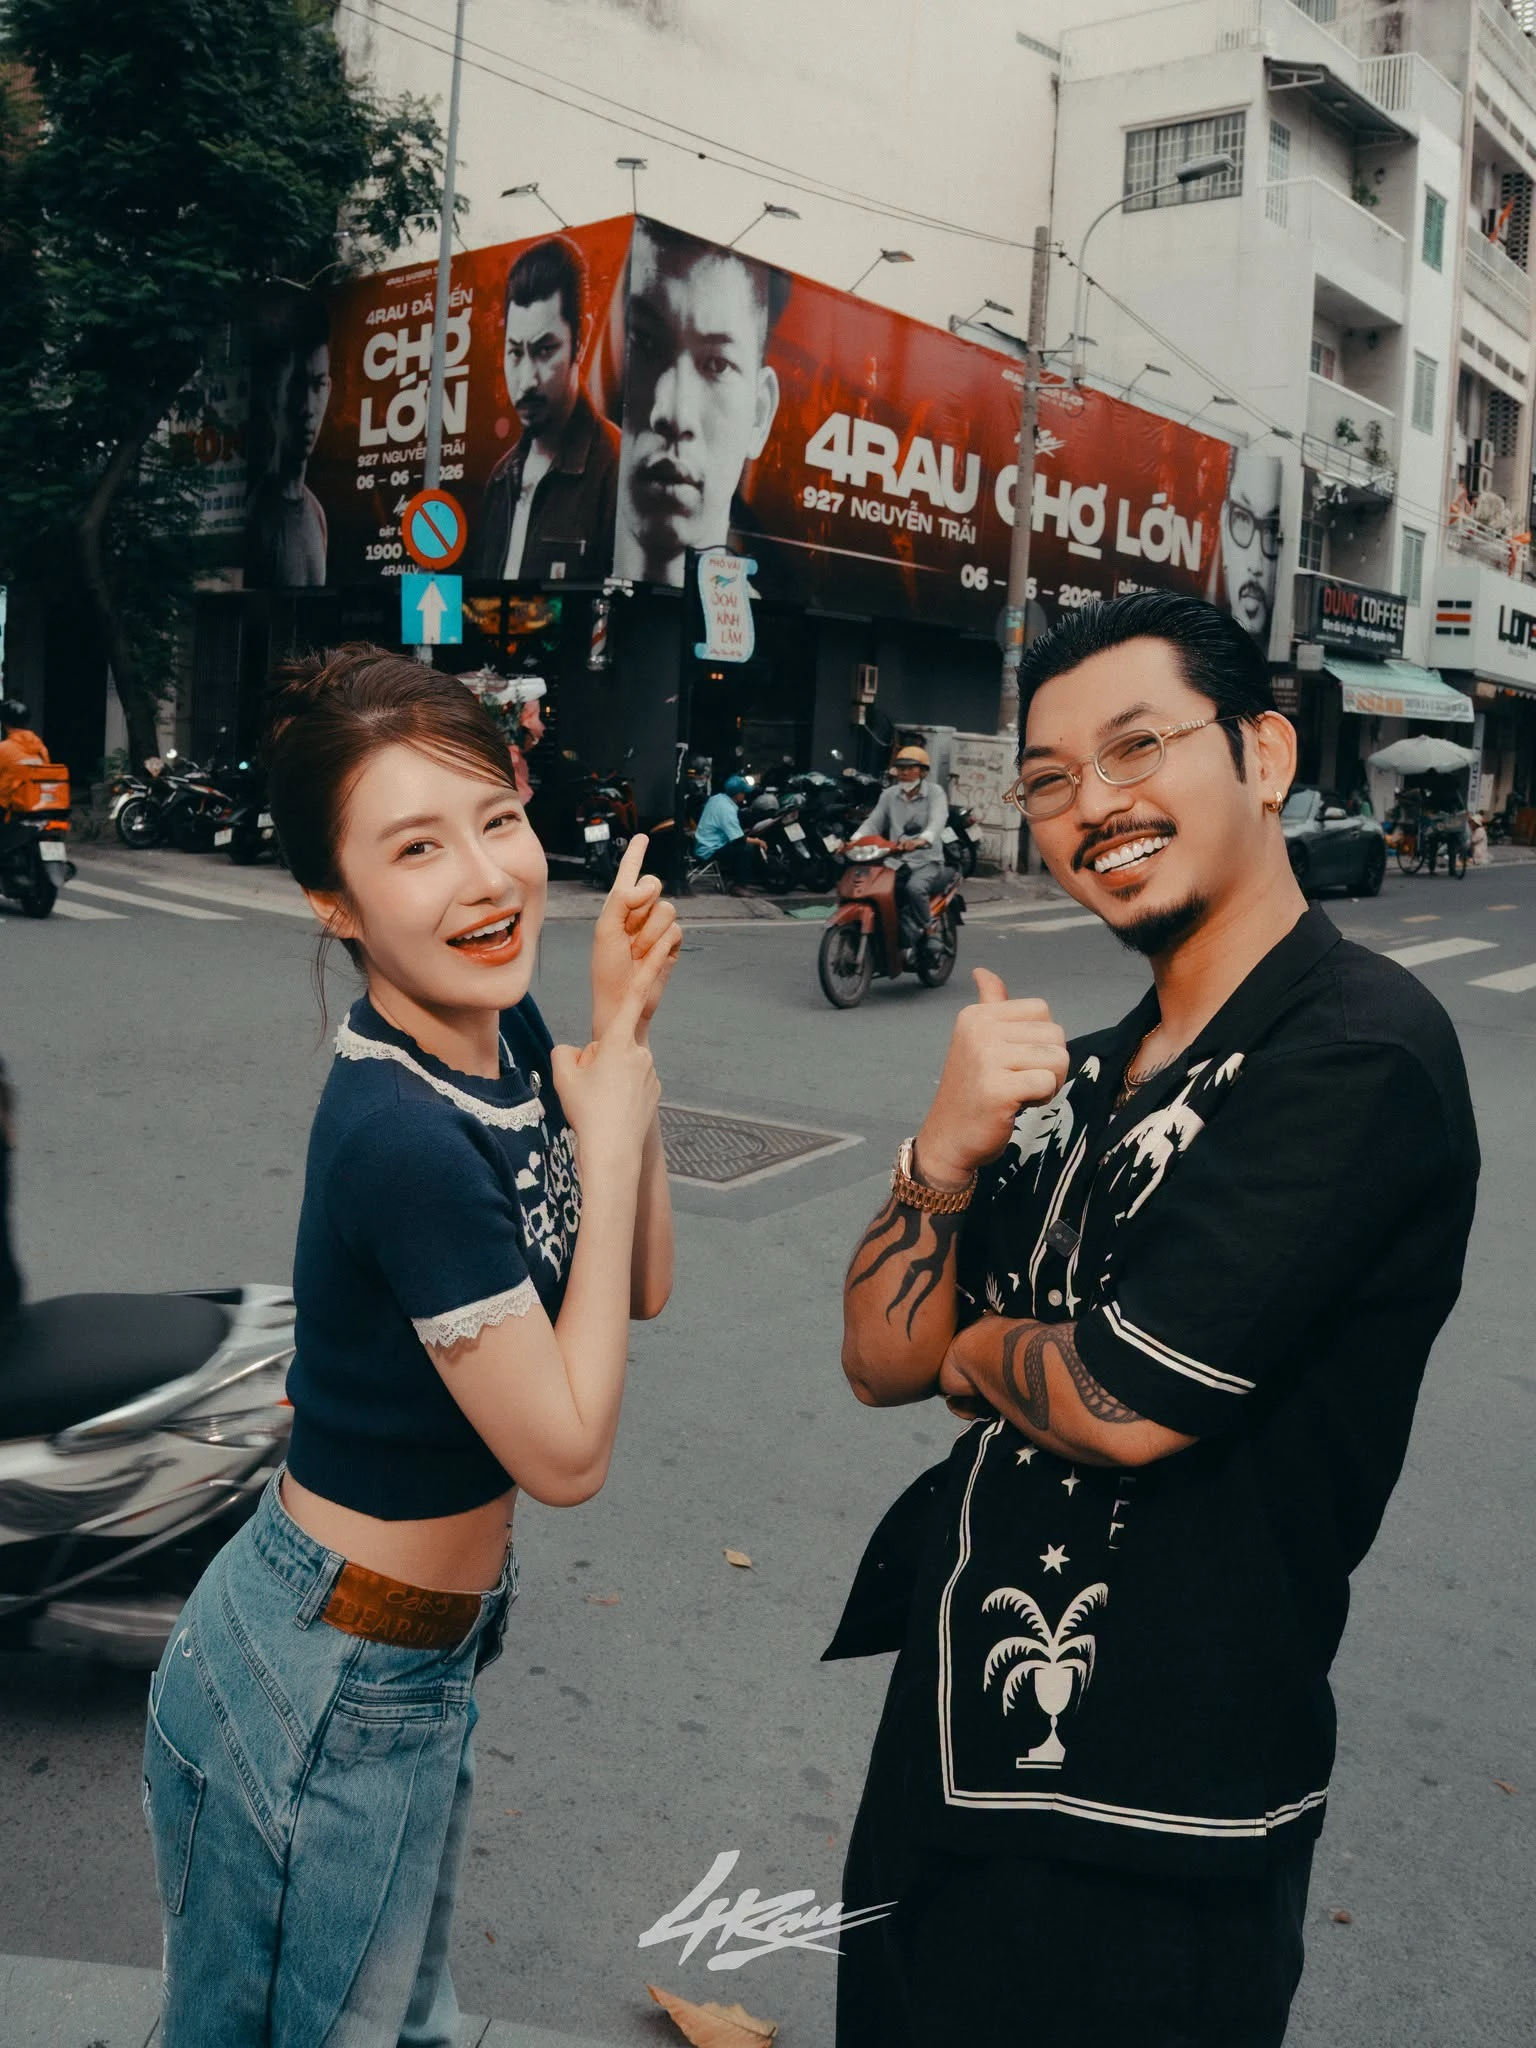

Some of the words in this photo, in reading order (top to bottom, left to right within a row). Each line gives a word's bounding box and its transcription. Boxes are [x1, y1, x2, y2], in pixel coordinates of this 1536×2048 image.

[366, 302, 408, 325] 4RAU
[411, 291, 434, 316] ĐÃ
[359, 371, 469, 447] LỚN
[357, 453, 379, 468] 927
[382, 440, 427, 465] NGUYỄ
[356, 474, 375, 490] 06
[390, 469, 410, 486] 06
[804, 411, 981, 514] 4RAU
[1115, 491, 1203, 572] LỚN
[803, 486, 845, 514] 927
[851, 500, 933, 534] NGUYỄN
[938, 517, 977, 545] TRÃI
[365, 542, 402, 560] 1900
[960, 563, 989, 591] 06
[1361, 596, 1405, 631] COFFEE
